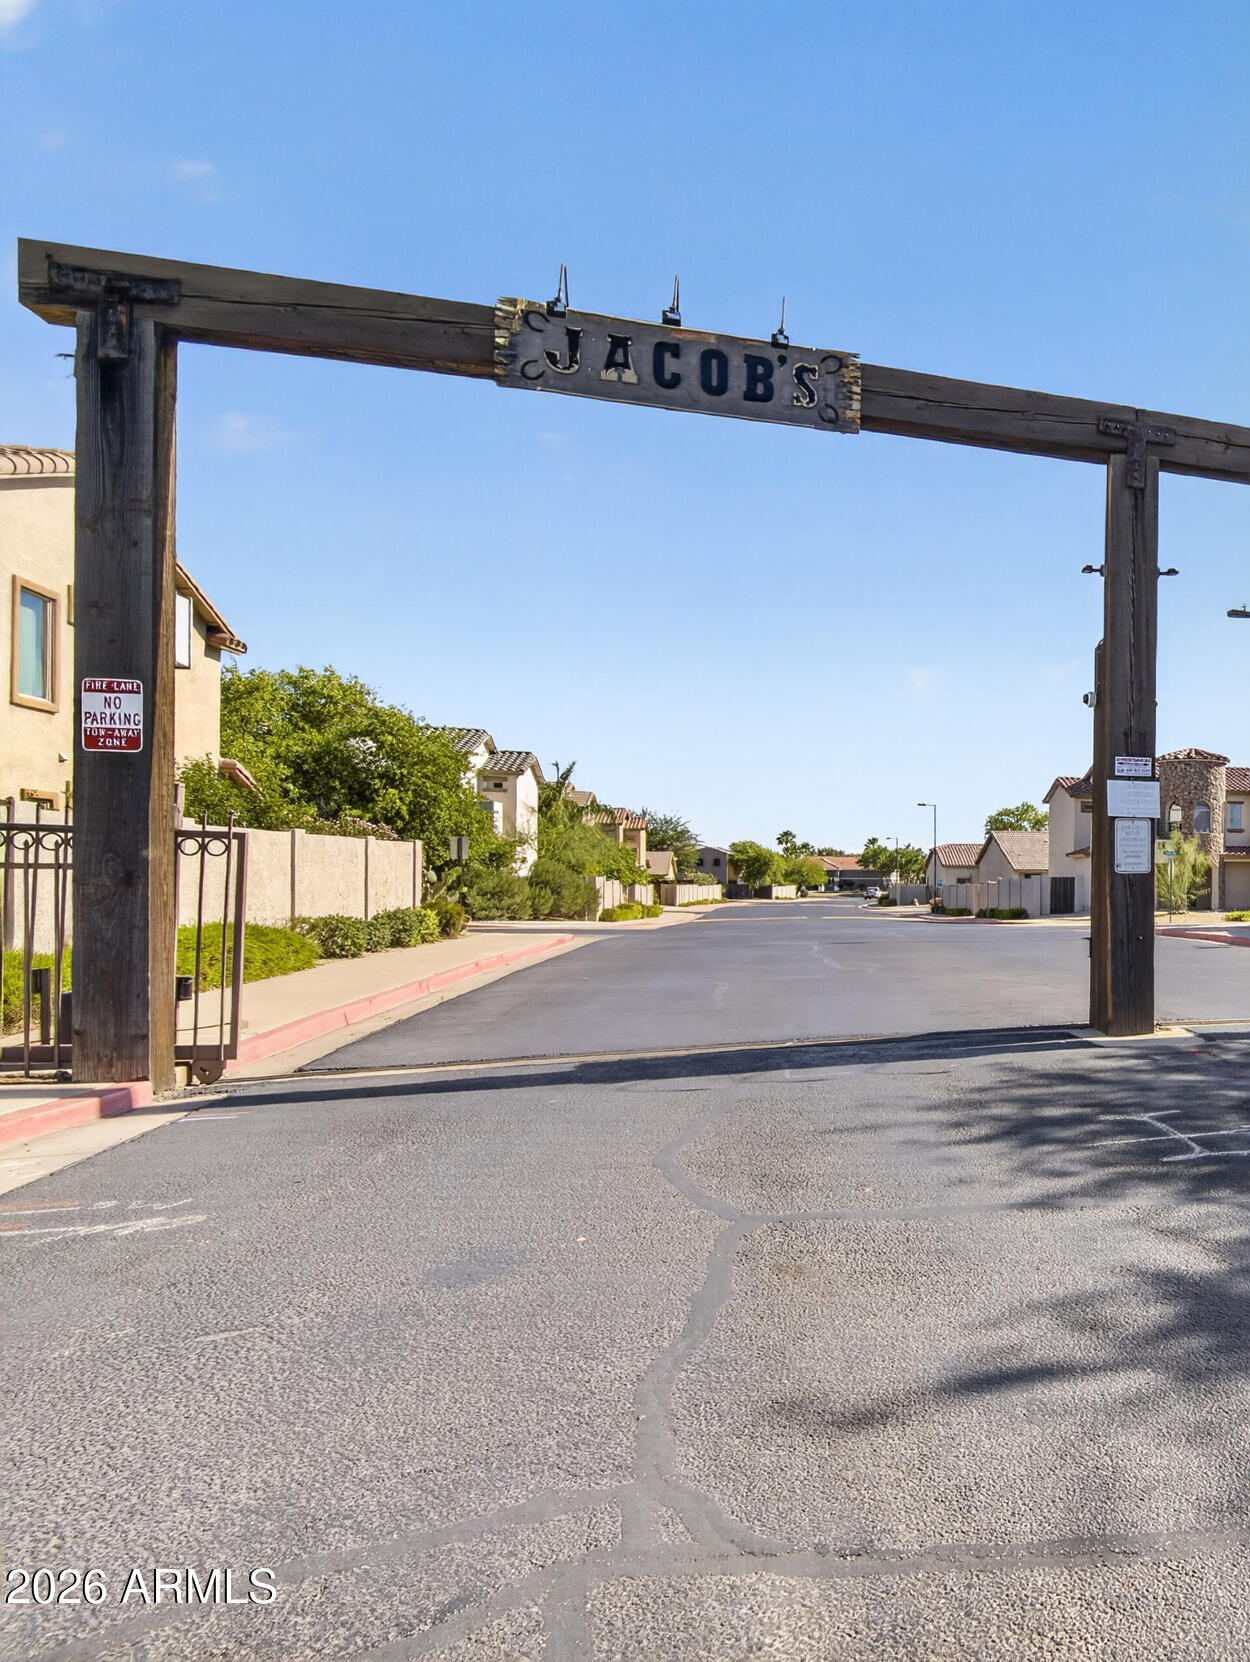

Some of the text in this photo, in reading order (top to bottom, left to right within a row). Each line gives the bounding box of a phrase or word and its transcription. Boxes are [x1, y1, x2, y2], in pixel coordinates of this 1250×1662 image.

[543, 326, 819, 409] JACOB'S
[85, 680, 139, 692] FIRE LANE
[104, 695, 122, 710] NO
[84, 711, 141, 727] PARKING
[85, 727, 140, 738] TOW-AWAY
[98, 737, 127, 747] ZONE
